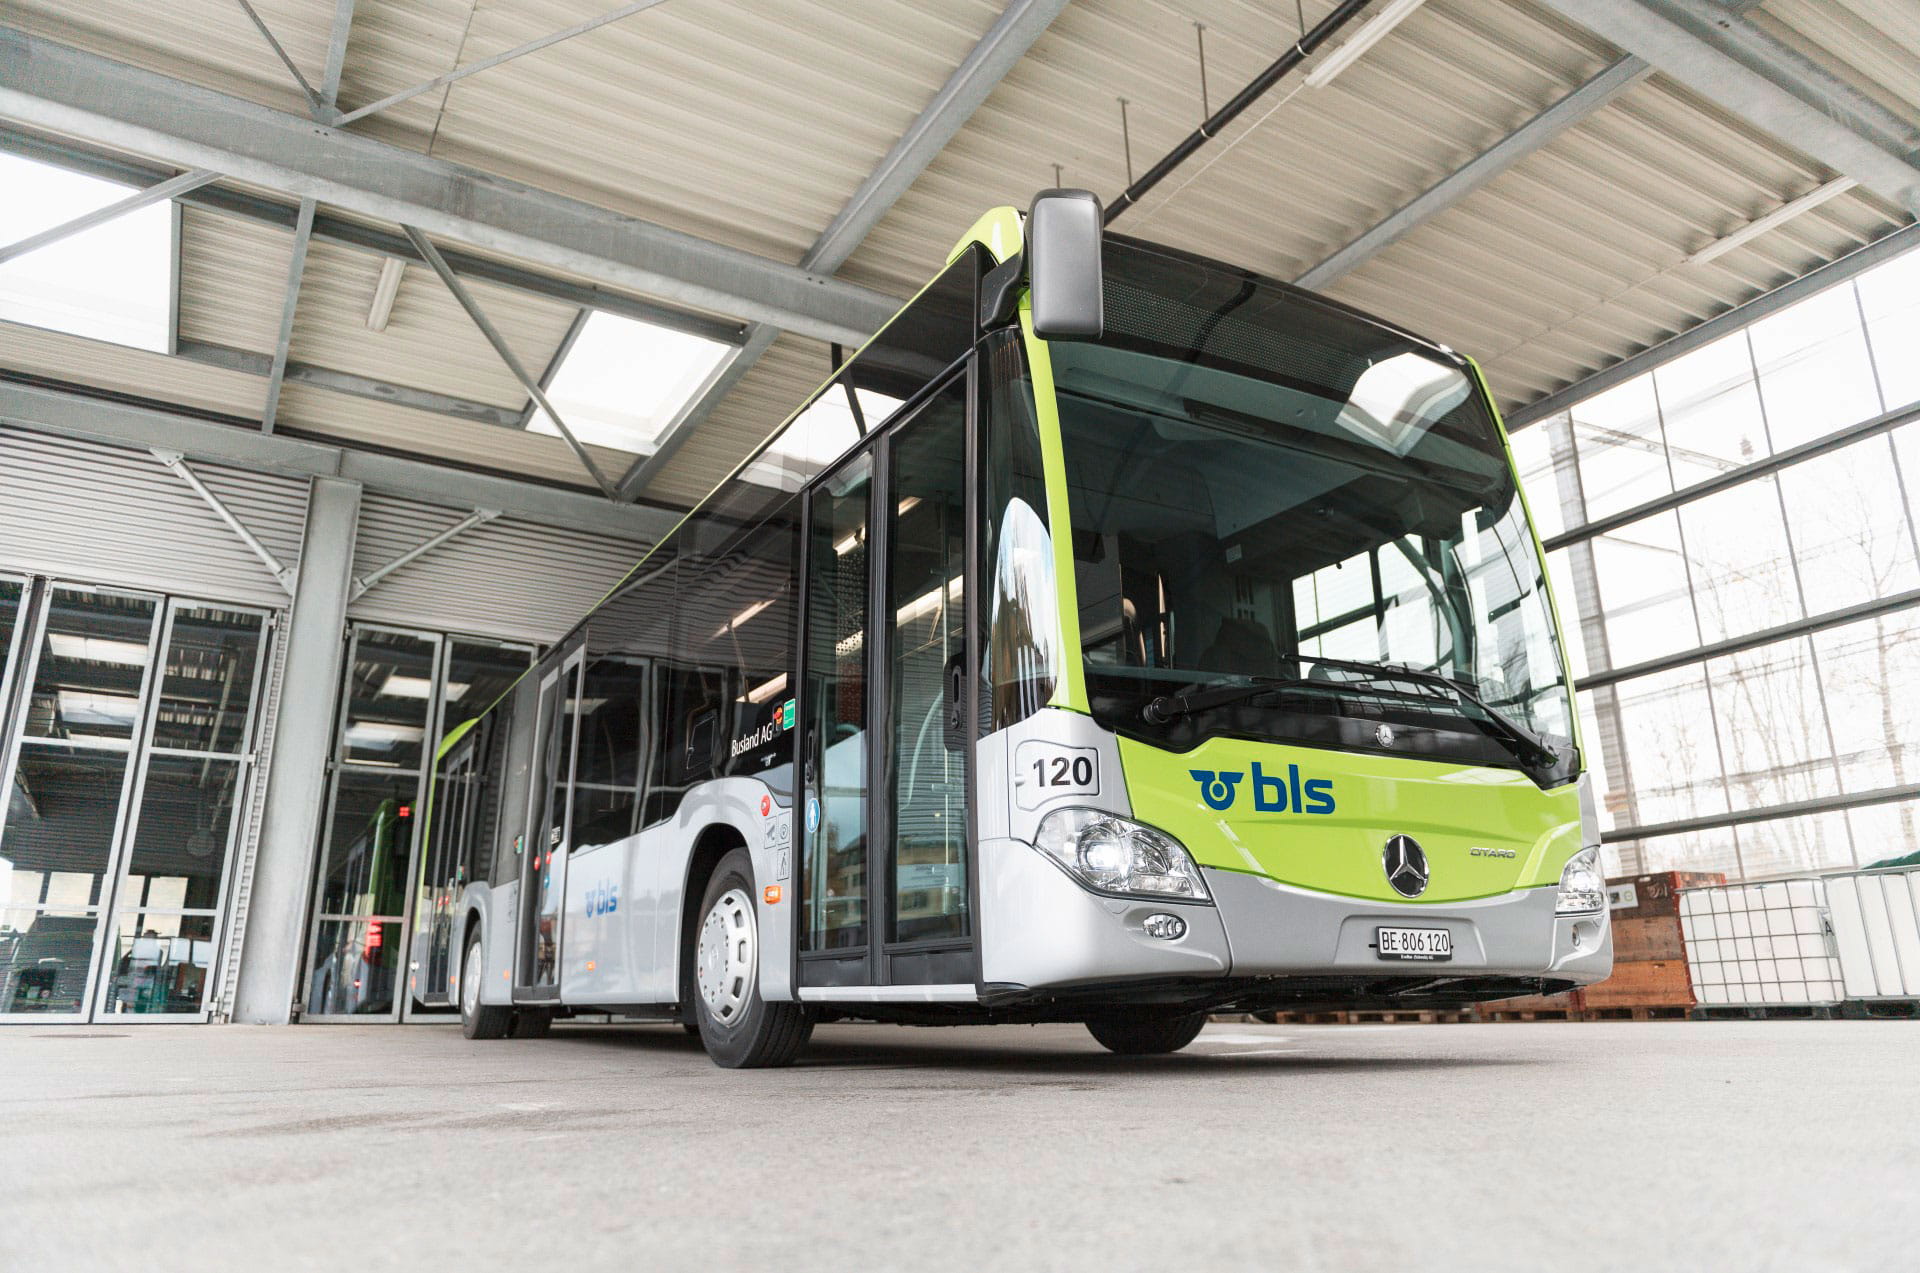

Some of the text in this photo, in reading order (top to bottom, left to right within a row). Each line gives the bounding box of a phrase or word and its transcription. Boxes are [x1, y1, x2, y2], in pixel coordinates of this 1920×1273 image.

[731, 722, 773, 757] Busland AG
[1033, 756, 1093, 787] 120
[1251, 761, 1336, 815] bls
[596, 877, 618, 915] bls
